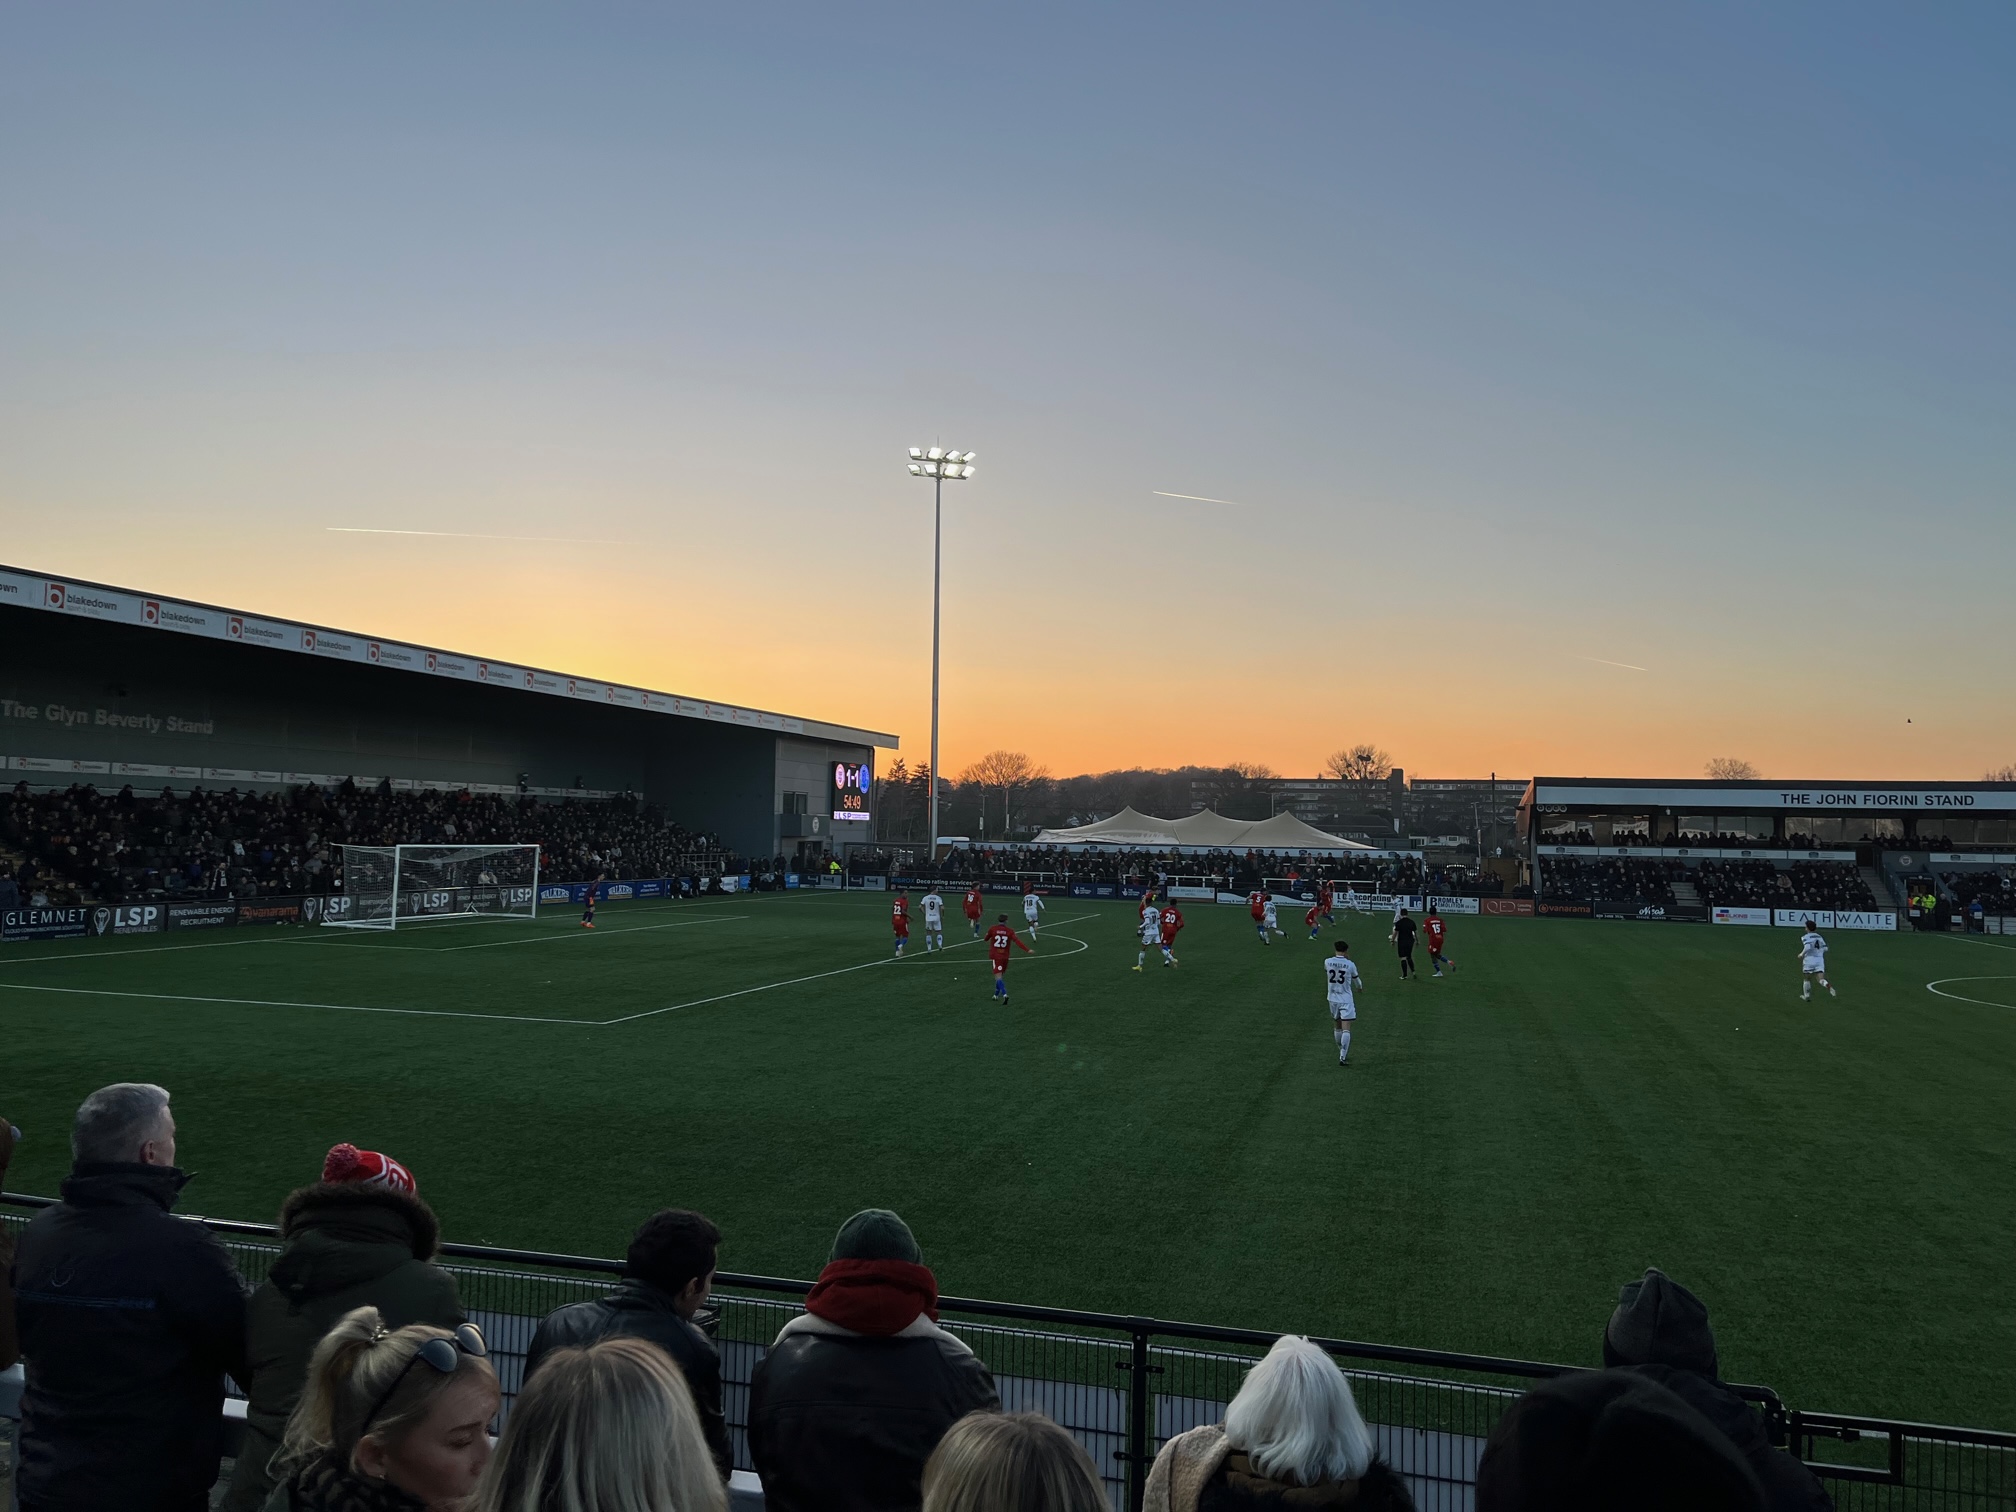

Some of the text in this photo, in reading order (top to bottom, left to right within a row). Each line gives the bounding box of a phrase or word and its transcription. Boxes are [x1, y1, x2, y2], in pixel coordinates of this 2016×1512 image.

[67, 593, 117, 610] blakedown
[161, 610, 205, 625] blakedown
[1, 700, 214, 734] The Glyn Beverly Stand
[844, 795, 861, 809] 54:49
[1781, 794, 1974, 806] THE JOHN FIORINI STAND
[511, 888, 532, 902] LSP
[541, 888, 569, 899] WALKERS
[608, 885, 632, 895] WALKERS
[424, 893, 449, 907] LSP
[930, 901, 934, 910] 9
[6, 909, 86, 925] GLEMNET
[115, 907, 157, 926] LSP
[169, 908, 209, 916] RENEWABLE
[1165, 913, 1176, 924] 20
[180, 917, 225, 926] RECRUITMENT
[1432, 924, 1440, 933] 15
[994, 935, 1008, 948] 23
[1815, 940, 1820, 949] 4
[1329, 969, 1345, 984] 23
